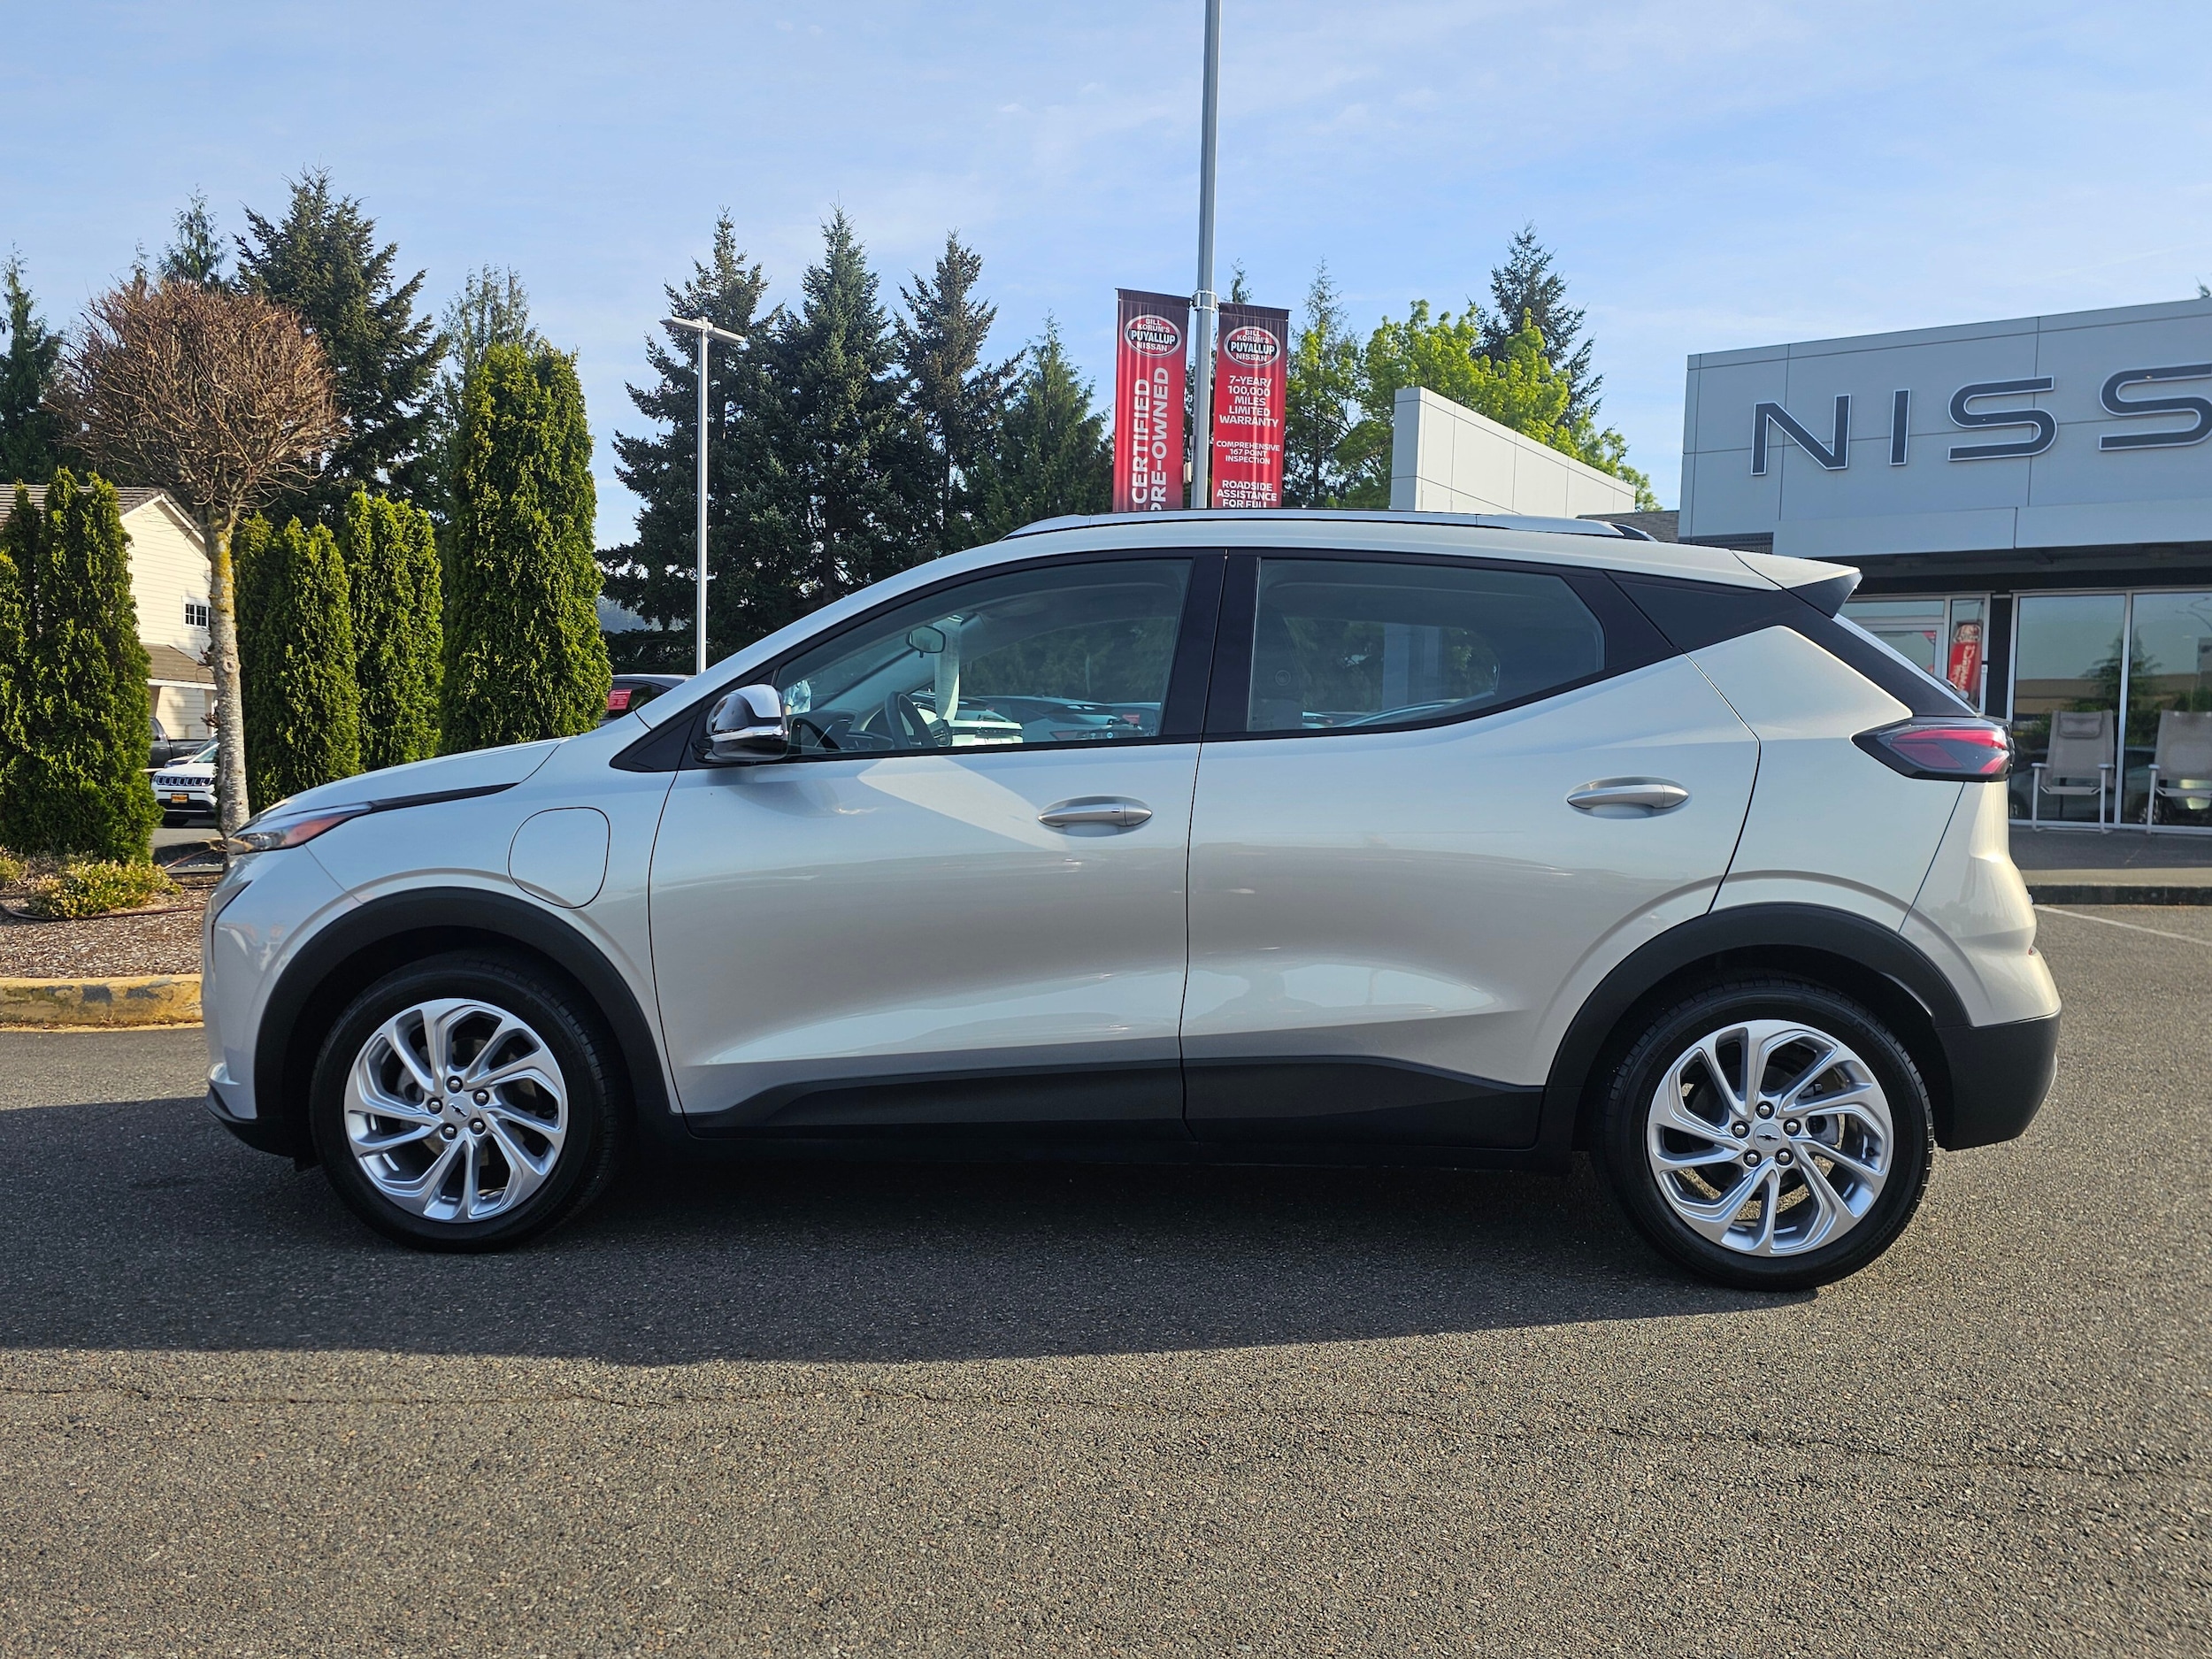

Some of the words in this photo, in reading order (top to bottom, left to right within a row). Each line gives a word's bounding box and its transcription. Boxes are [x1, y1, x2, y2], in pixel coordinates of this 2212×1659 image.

[1137, 323, 1171, 333] KORUM'S
[1131, 329, 1176, 345] PUYALLUP
[1236, 334, 1270, 344] KORUM'S
[1136, 342, 1168, 352] NISSAN
[1231, 342, 1275, 356] PUYALLUP
[1236, 353, 1268, 362] NISSAN
[1229, 375, 1272, 388] 7-YEAR/
[1227, 385, 1271, 397] 100,000
[1234, 396, 1266, 406] MILES
[1228, 405, 1271, 417] LIMITED
[1219, 414, 1279, 427] WARRANTY
[1131, 379, 1150, 504] CERTIFIED
[1150, 367, 1169, 511] PRE-OWNED
[1216, 441, 1280, 451] COMPREHENSIVE
[1225, 455, 1271, 465] INSPECTION
[1222, 480, 1273, 492] ROADSIDE
[1217, 488, 1278, 502] ASSISTANCE
[1223, 498, 1244, 508] FOR
